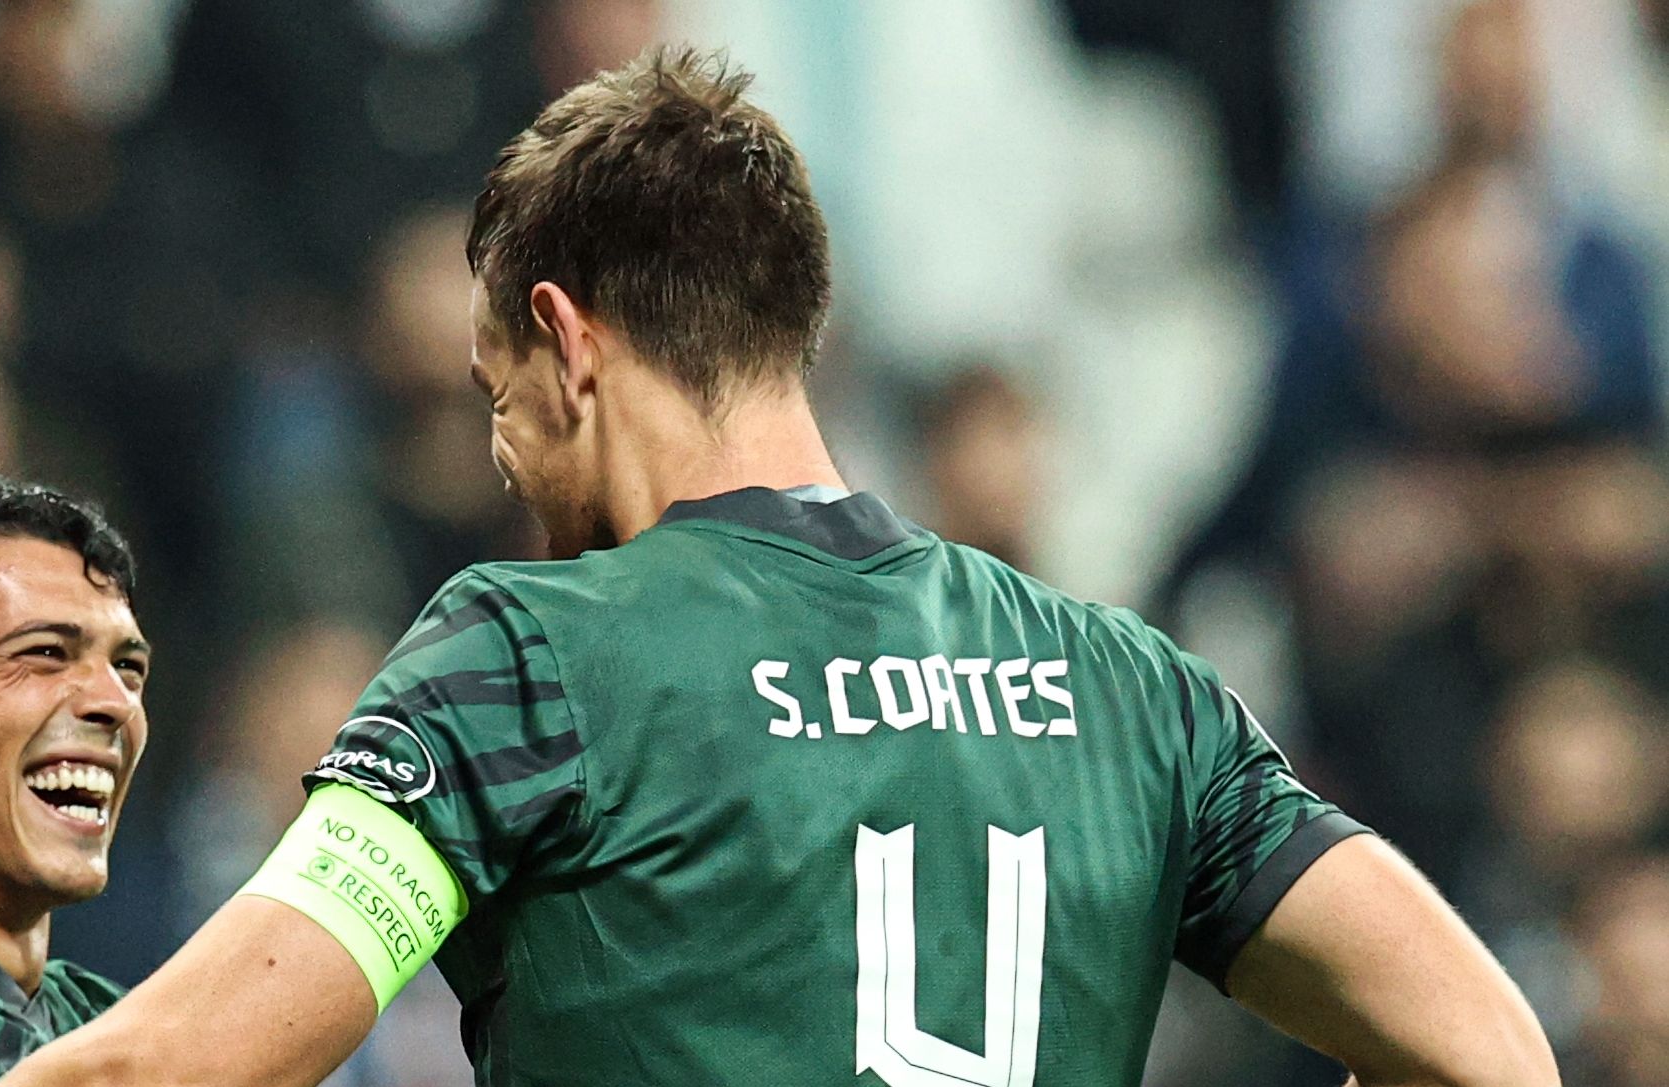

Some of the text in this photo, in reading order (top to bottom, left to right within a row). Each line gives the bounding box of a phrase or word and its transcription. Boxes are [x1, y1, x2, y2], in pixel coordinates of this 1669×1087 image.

[751, 654, 1077, 739] S.COATES
[319, 818, 445, 944] NO TO RACISM
[339, 873, 416, 963] RESPECT
